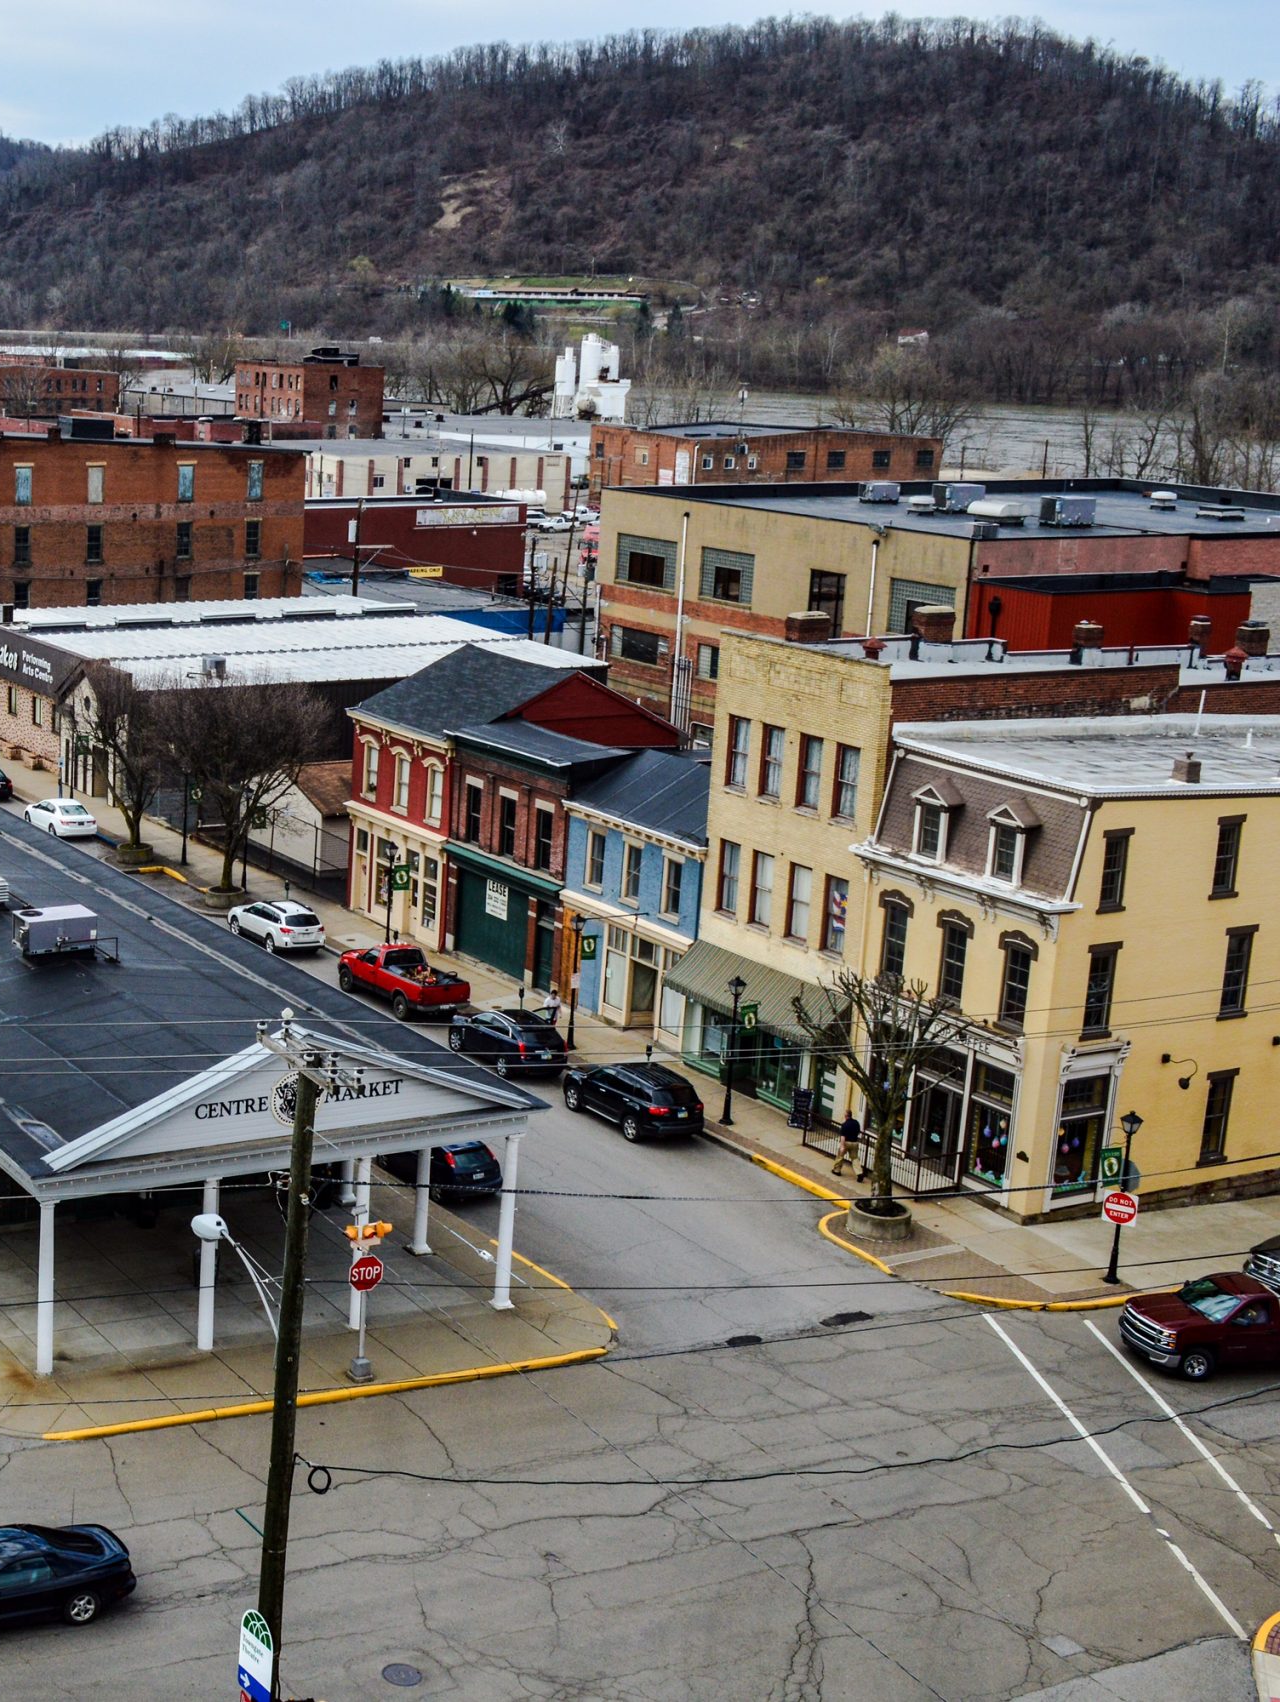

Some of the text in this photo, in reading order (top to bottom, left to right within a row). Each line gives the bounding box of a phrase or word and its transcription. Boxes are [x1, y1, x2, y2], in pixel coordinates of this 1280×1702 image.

[22, 650, 52, 673] Performing
[22, 663, 34, 677] Arts
[488, 880, 507, 897] LEASE
[194, 1078, 404, 1120] CENTRE MARKET
[1108, 1196, 1133, 1206] DO NOT
[1109, 1210, 1129, 1219] ENTER
[351, 1265, 381, 1281] STOP
